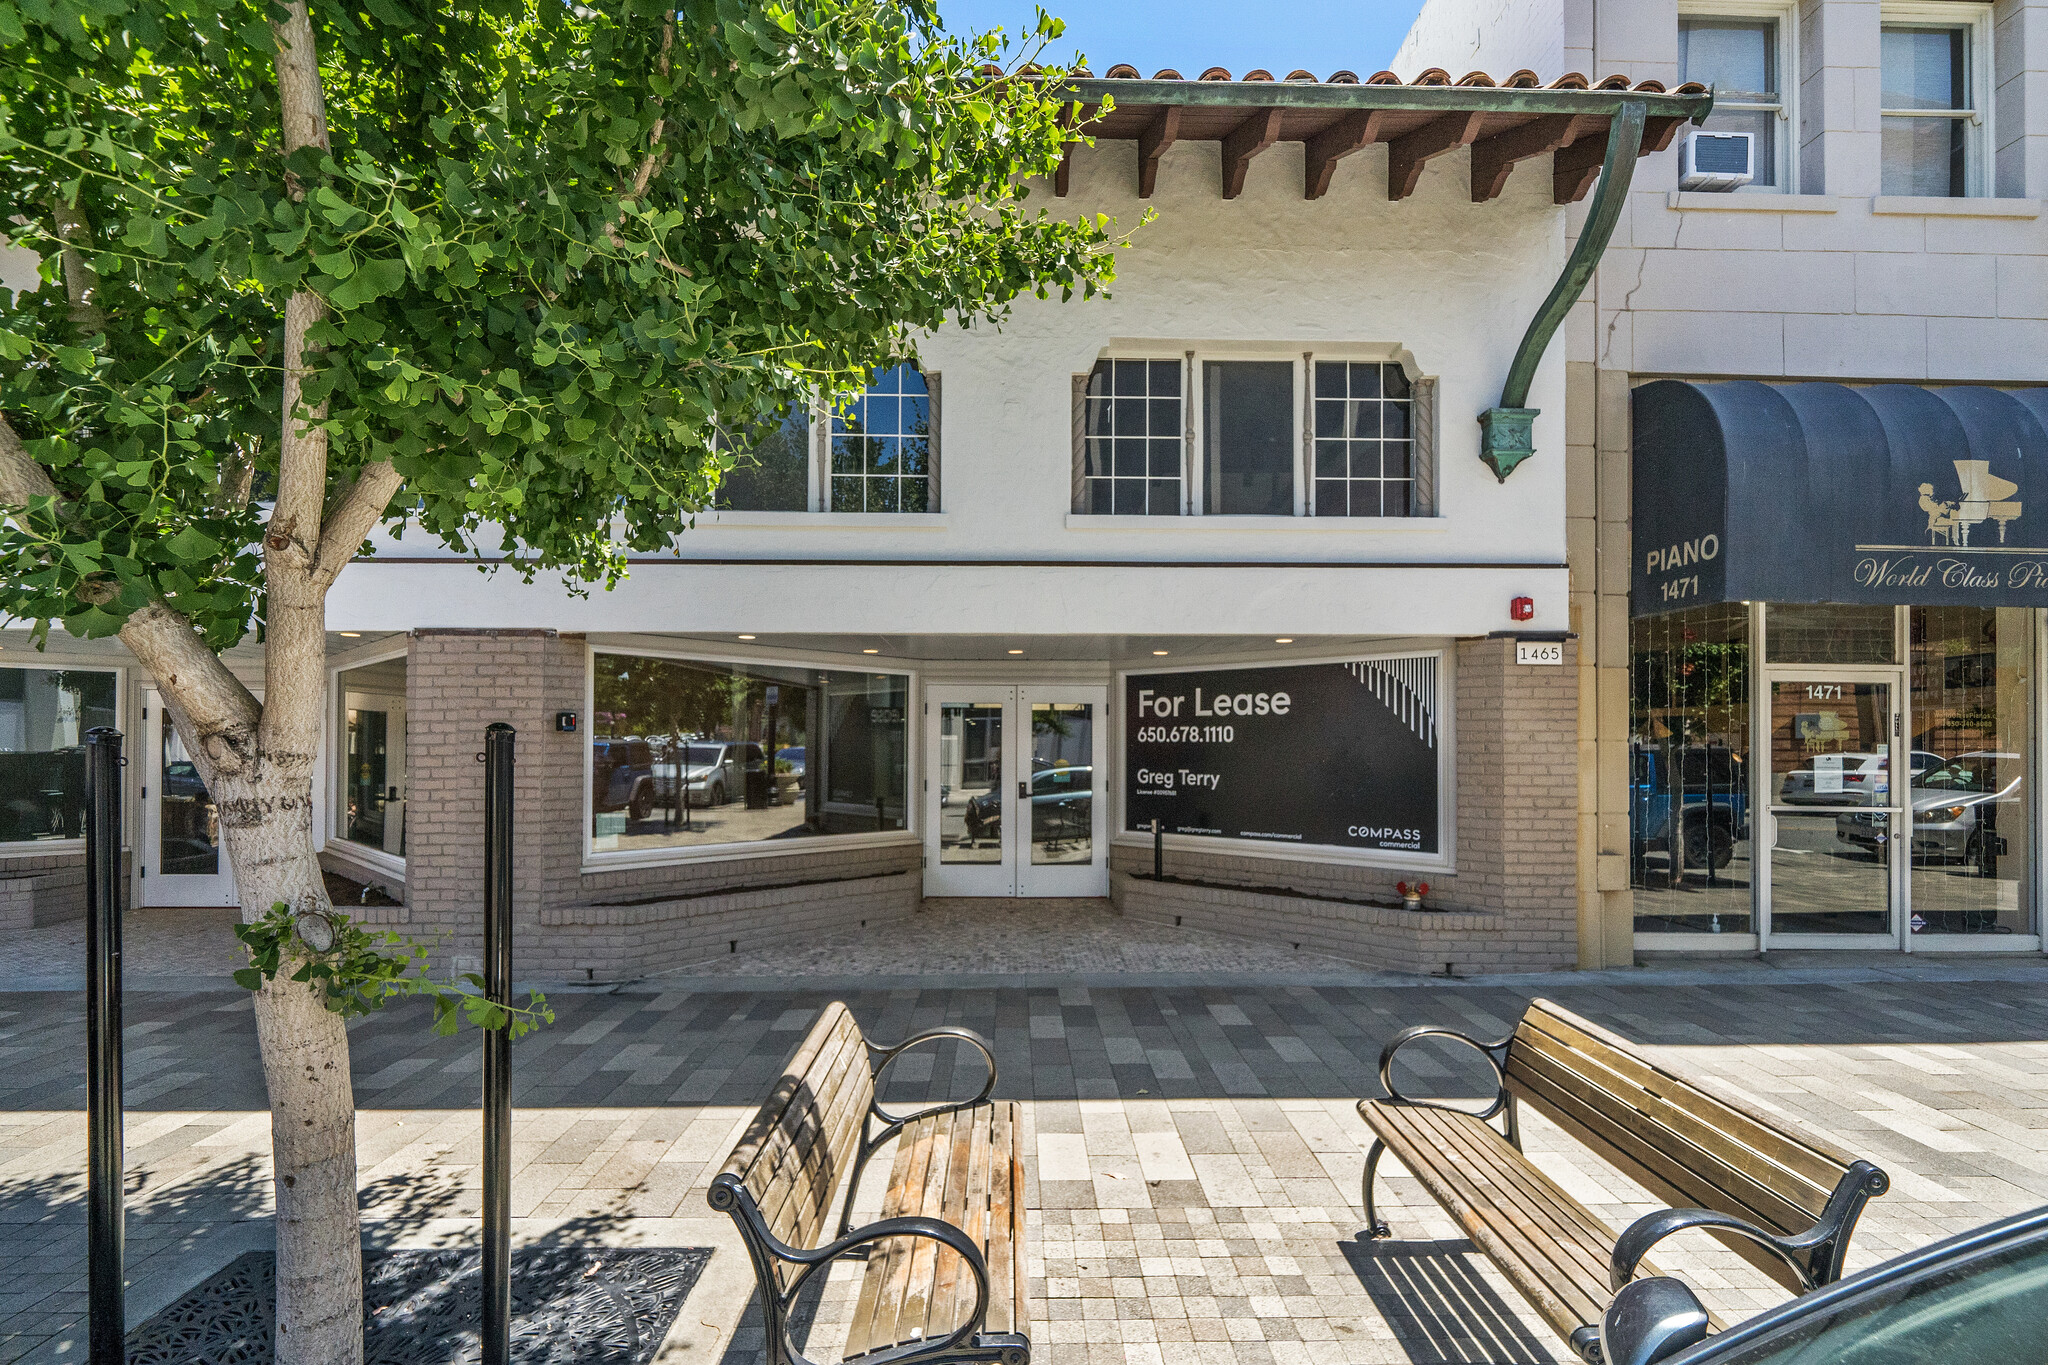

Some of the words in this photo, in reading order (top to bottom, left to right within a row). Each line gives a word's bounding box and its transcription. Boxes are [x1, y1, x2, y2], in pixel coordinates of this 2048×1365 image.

[1646, 533, 1719, 575] PIANO
[1853, 555, 1933, 589] World
[1936, 558, 2000, 589] Class
[1660, 574, 1699, 602] 1471
[1520, 647, 1560, 660] 1465
[1805, 684, 1842, 700] 1471
[1138, 689, 1186, 718] For
[1194, 687, 1292, 717] Lease
[1137, 725, 1235, 743] 650.678.1110
[1137, 768, 1174, 789] Greg
[1178, 769, 1221, 791] Terry
[1347, 825, 1421, 841] COMPASS
[1379, 841, 1421, 849] commercial
